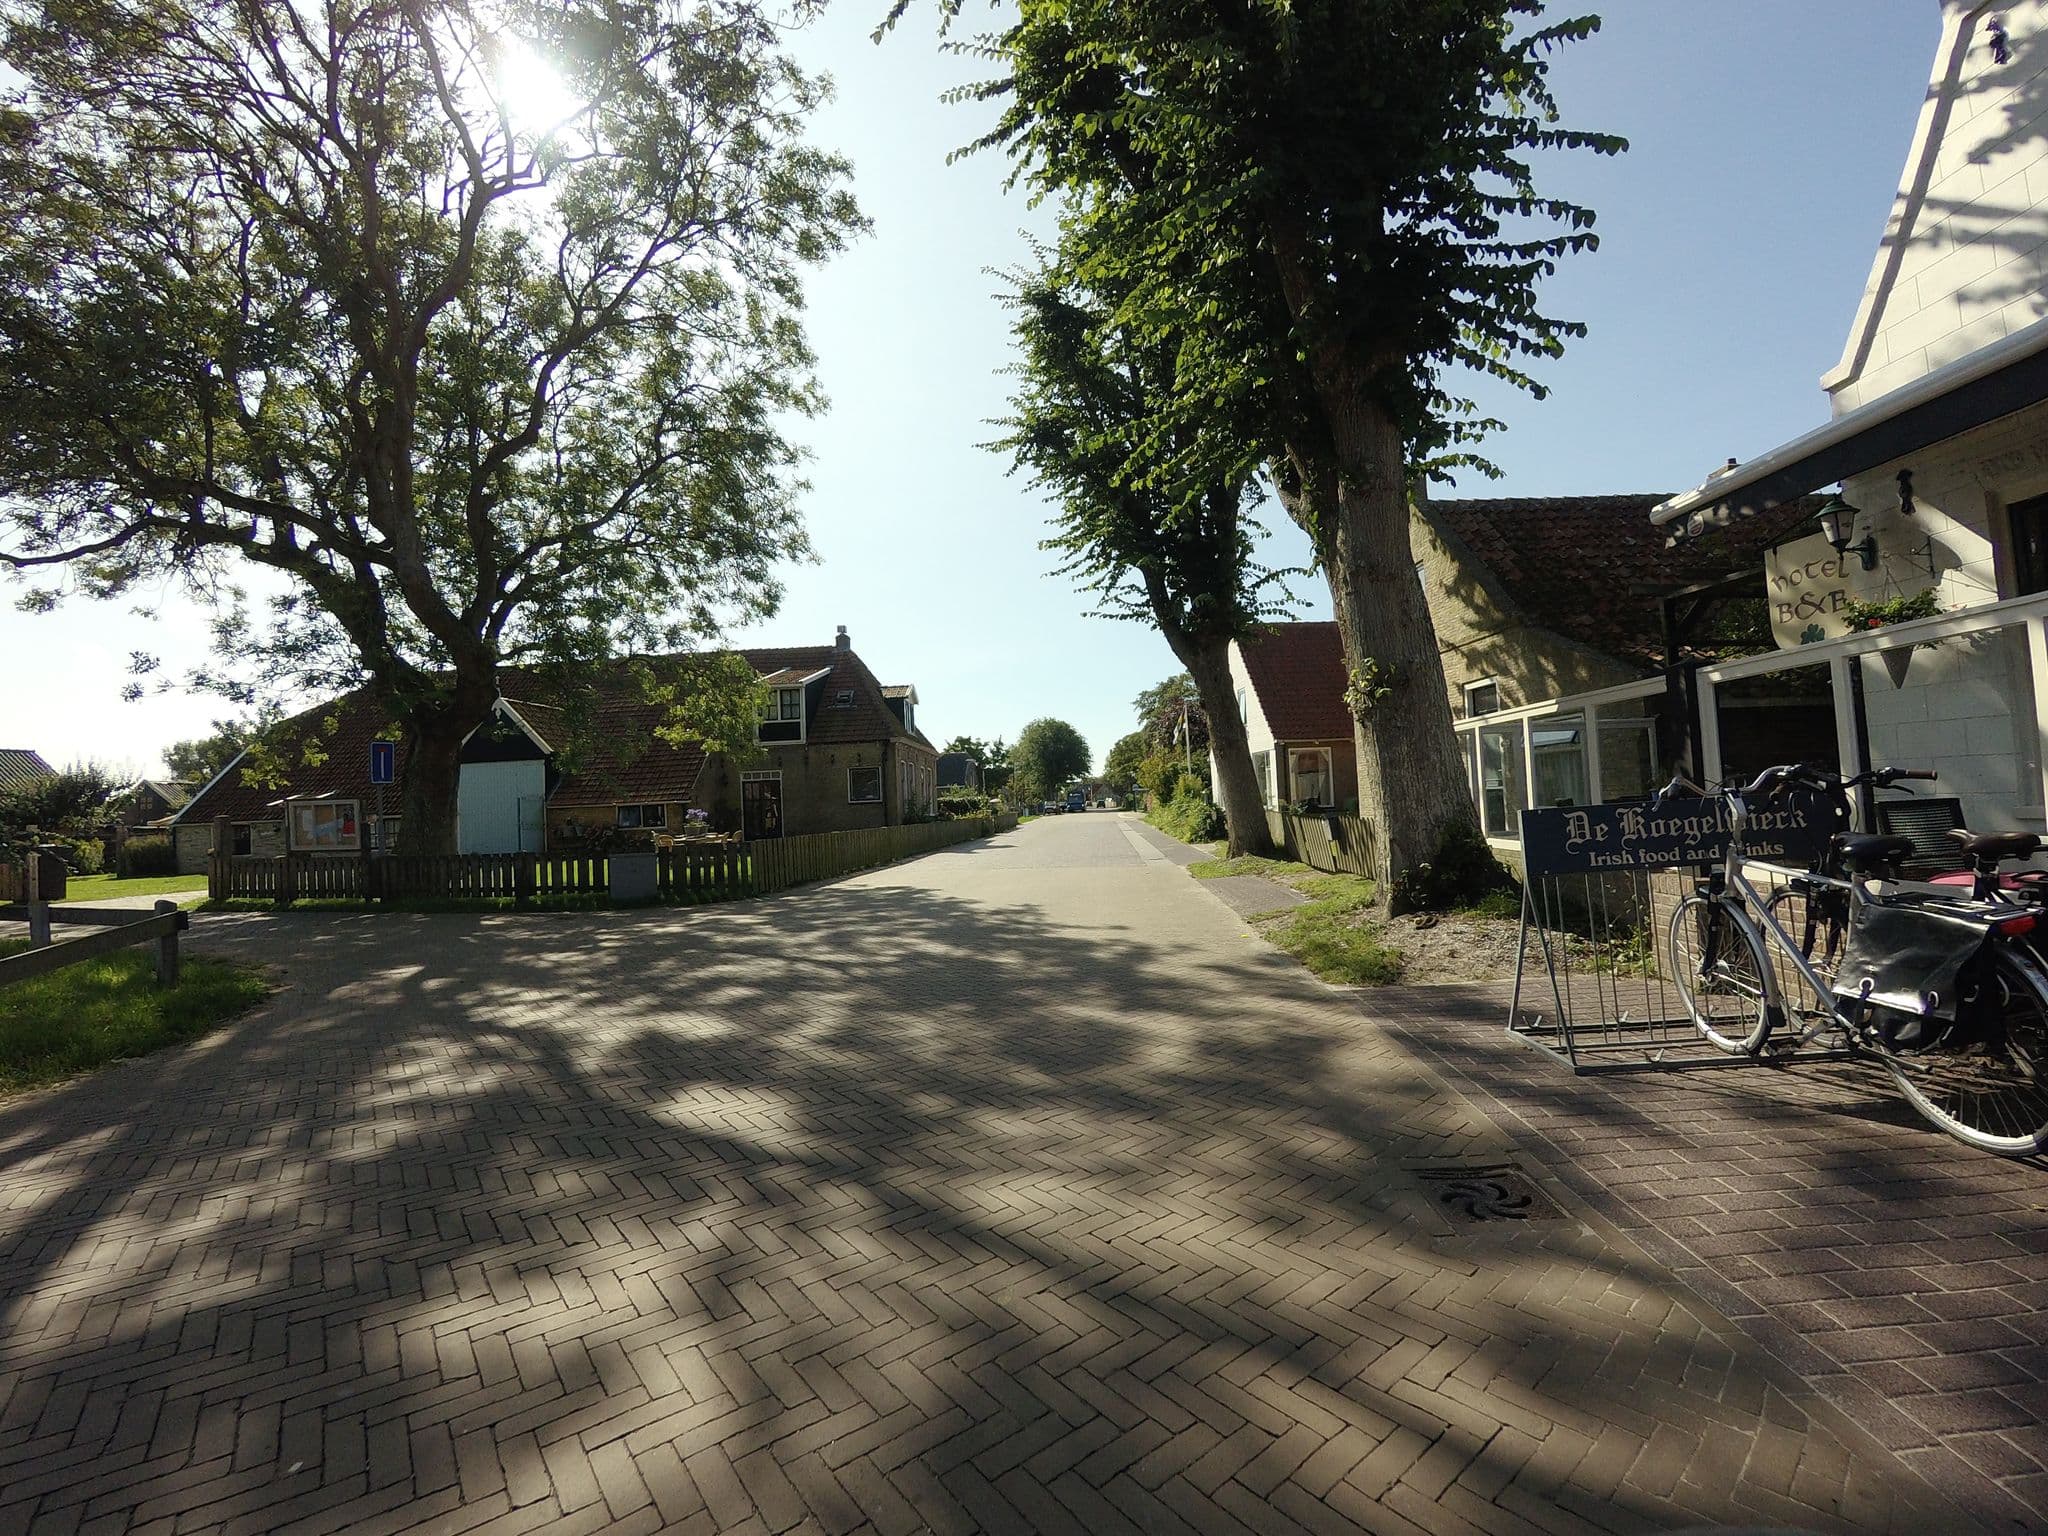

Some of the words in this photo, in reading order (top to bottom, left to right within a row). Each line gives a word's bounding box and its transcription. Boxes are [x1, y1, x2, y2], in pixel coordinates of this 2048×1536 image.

[1776, 589, 1849, 624] B&B
[1563, 811, 1608, 854] De
[1588, 851, 1635, 867] Irish
[1638, 847, 1681, 863] food
[1686, 844, 1720, 861] and
[1738, 841, 1785, 857] inks
